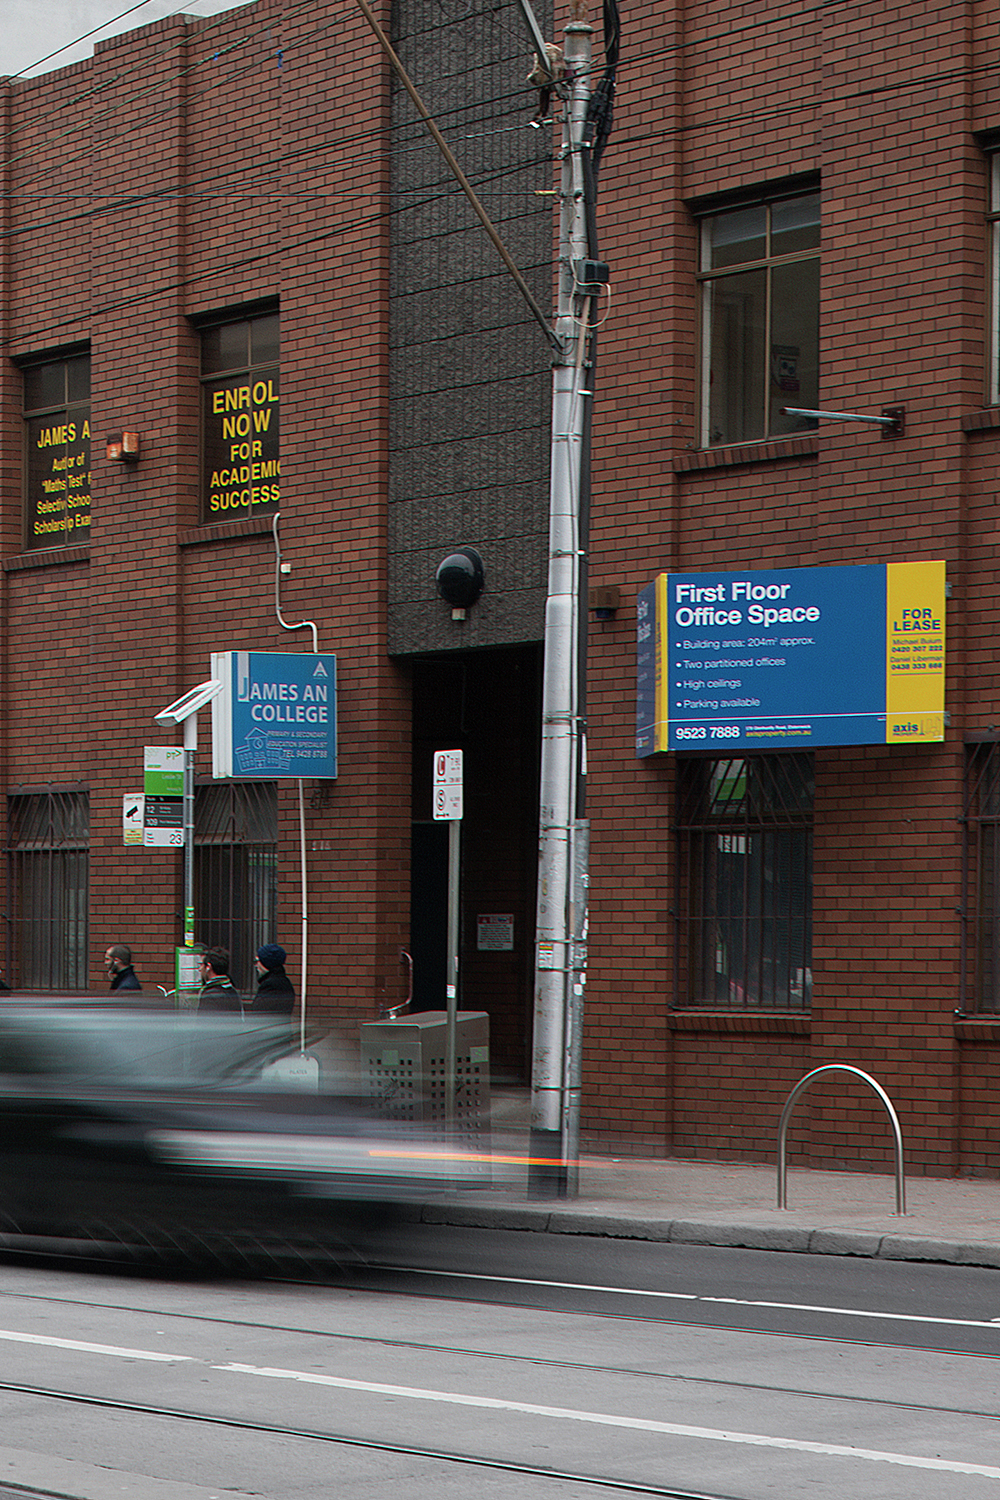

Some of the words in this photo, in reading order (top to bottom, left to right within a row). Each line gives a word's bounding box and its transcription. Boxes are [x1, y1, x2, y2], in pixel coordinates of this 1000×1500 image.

[212, 380, 280, 414] ENROL
[222, 409, 272, 440] NOW
[36, 423, 76, 448] JAMES
[230, 440, 263, 462] FOR
[76, 452, 85, 467] of
[210, 484, 281, 512] SUCCESS
[675, 583, 726, 604] First
[731, 581, 791, 602] Floor
[675, 605, 743, 627] Office
[748, 604, 821, 627] Space
[902, 608, 933, 620] FOR
[893, 619, 942, 632] LEASE
[683, 638, 720, 651] Building
[721, 639, 746, 649] area:
[779, 636, 816, 649] approx.
[683, 659, 703, 669] Two
[704, 657, 754, 671] partitioned
[755, 656, 786, 667] offices
[683, 680, 705, 692] High
[706, 678, 742, 690] ceilings
[303, 684, 328, 702] AN
[683, 699, 718, 712] Parking
[719, 697, 760, 709] available
[251, 704, 328, 723] COLLEGE
[675, 727, 707, 739] 9523
[708, 726, 740, 738] 7888
[892, 722, 919, 732] axis
[169, 833, 182, 845] 23
